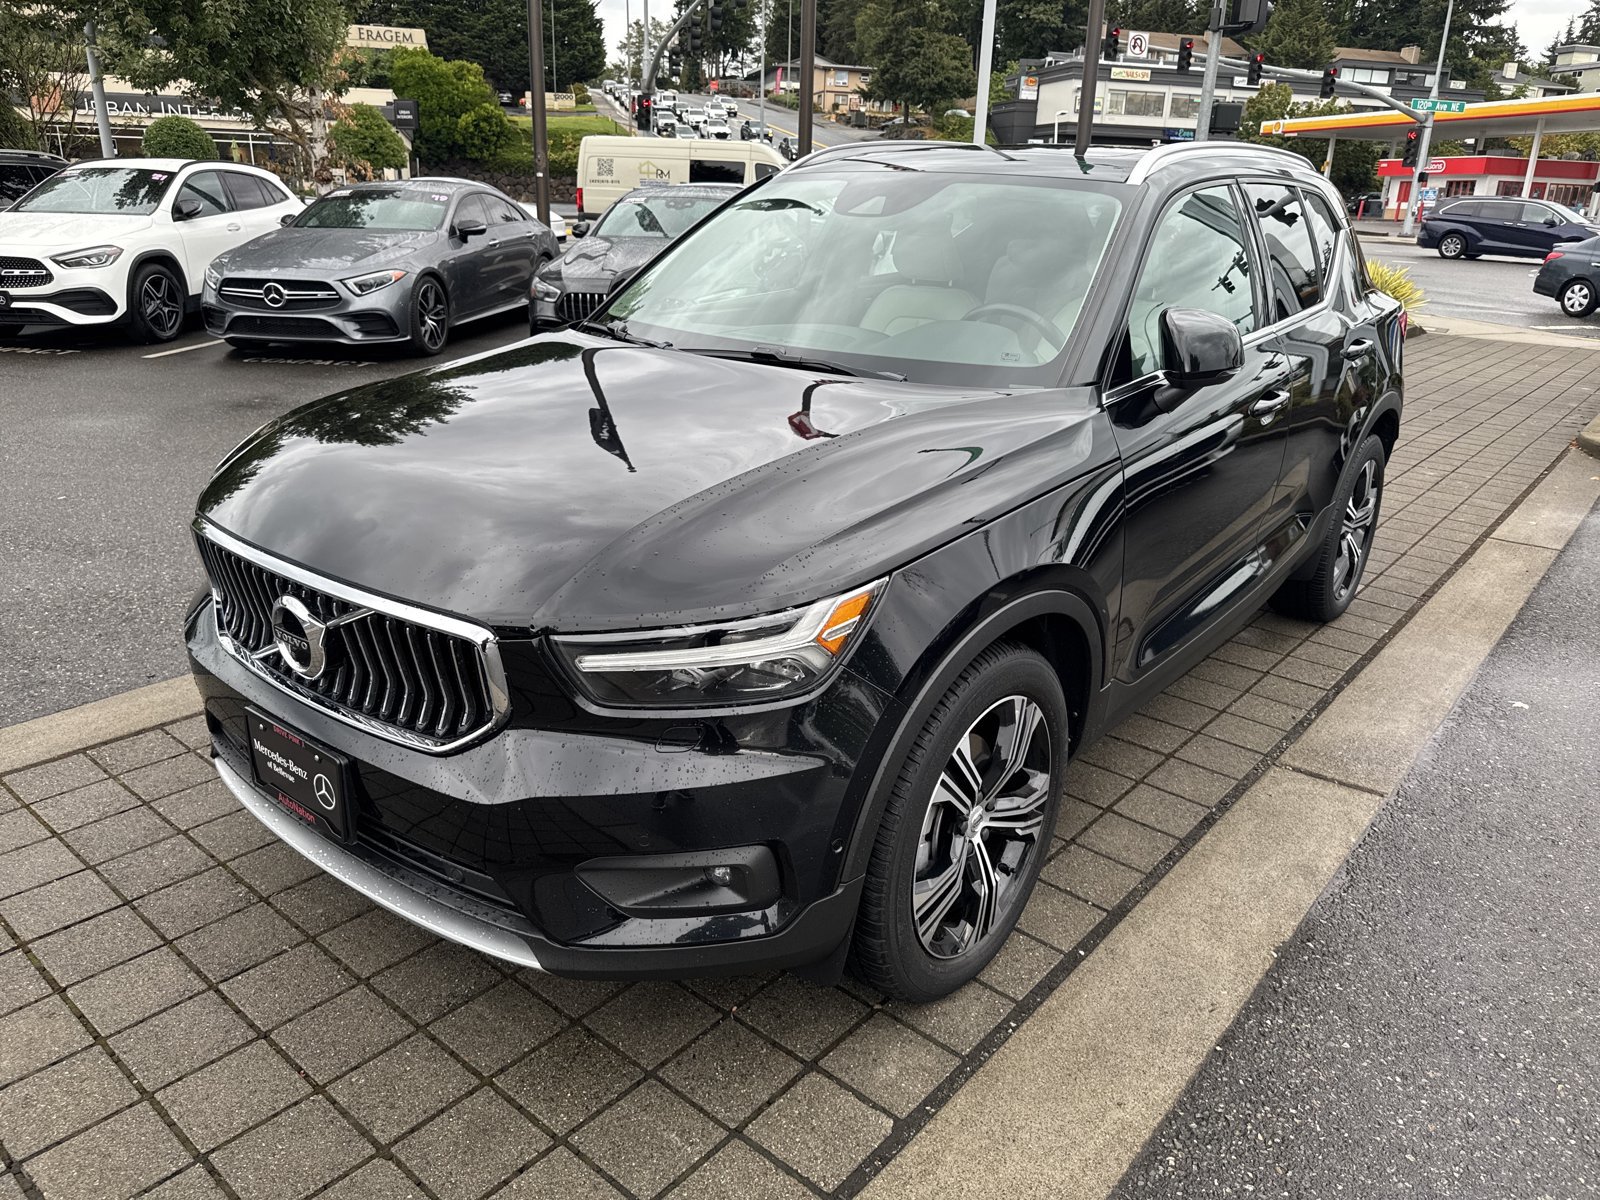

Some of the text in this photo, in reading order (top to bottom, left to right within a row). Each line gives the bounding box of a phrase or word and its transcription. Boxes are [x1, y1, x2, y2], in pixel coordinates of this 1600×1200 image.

[358, 27, 414, 43] ERAGEM
[553, 93, 573, 101] 12000
[1435, 101, 1448, 111] Ave
[1450, 102, 1460, 112] NE
[275, 628, 308, 650] VOLVO
[253, 738, 308, 780] Mercedes-Benz
[272, 764, 296, 784] Bellevue
[278, 792, 317, 825] AutoNation
